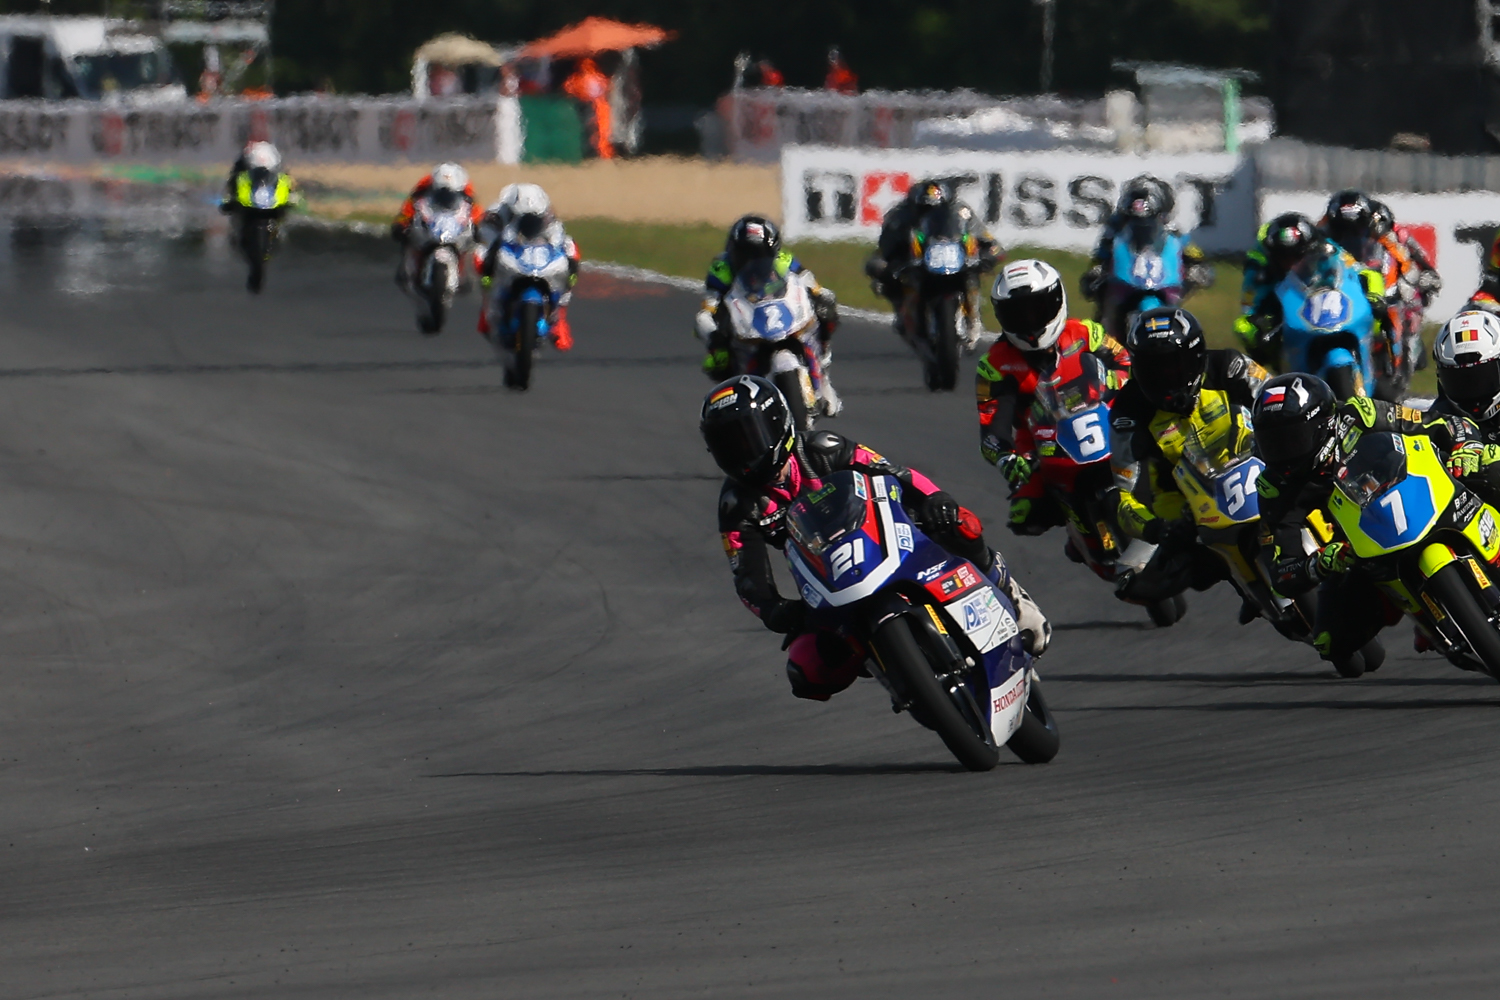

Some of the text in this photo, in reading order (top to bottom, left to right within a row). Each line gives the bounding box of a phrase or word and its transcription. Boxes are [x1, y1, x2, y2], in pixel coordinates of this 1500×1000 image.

[763, 304, 785, 331] 2
[1072, 412, 1105, 457] 5
[1380, 489, 1408, 536] 7
[830, 537, 865, 582] 21
[916, 560, 948, 580] NSF
